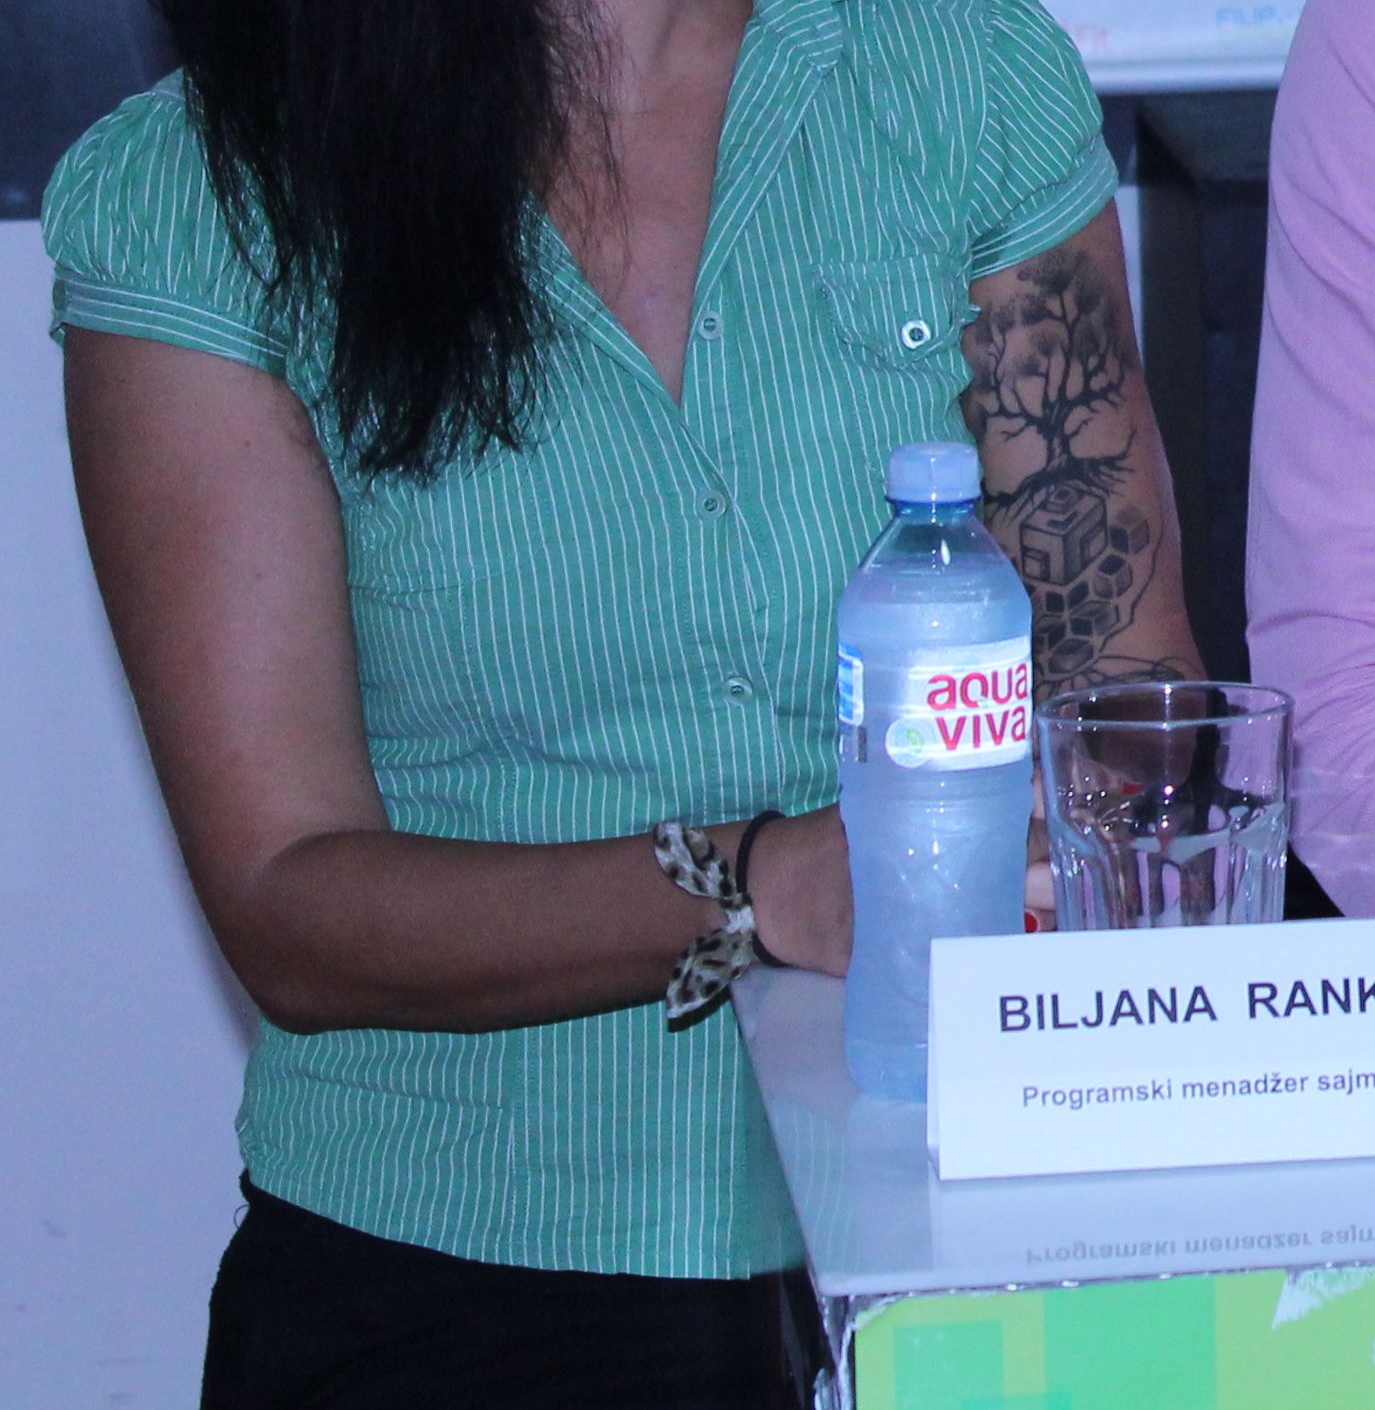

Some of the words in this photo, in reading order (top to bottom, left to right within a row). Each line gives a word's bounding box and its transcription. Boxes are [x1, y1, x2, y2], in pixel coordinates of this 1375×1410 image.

[927, 663, 1028, 711] aqua
[935, 705, 1026, 751] viva
[999, 985, 1218, 1033] BILJANA
[1022, 1077, 1172, 1111] Programski
[1181, 1064, 1309, 1099] menadžer
